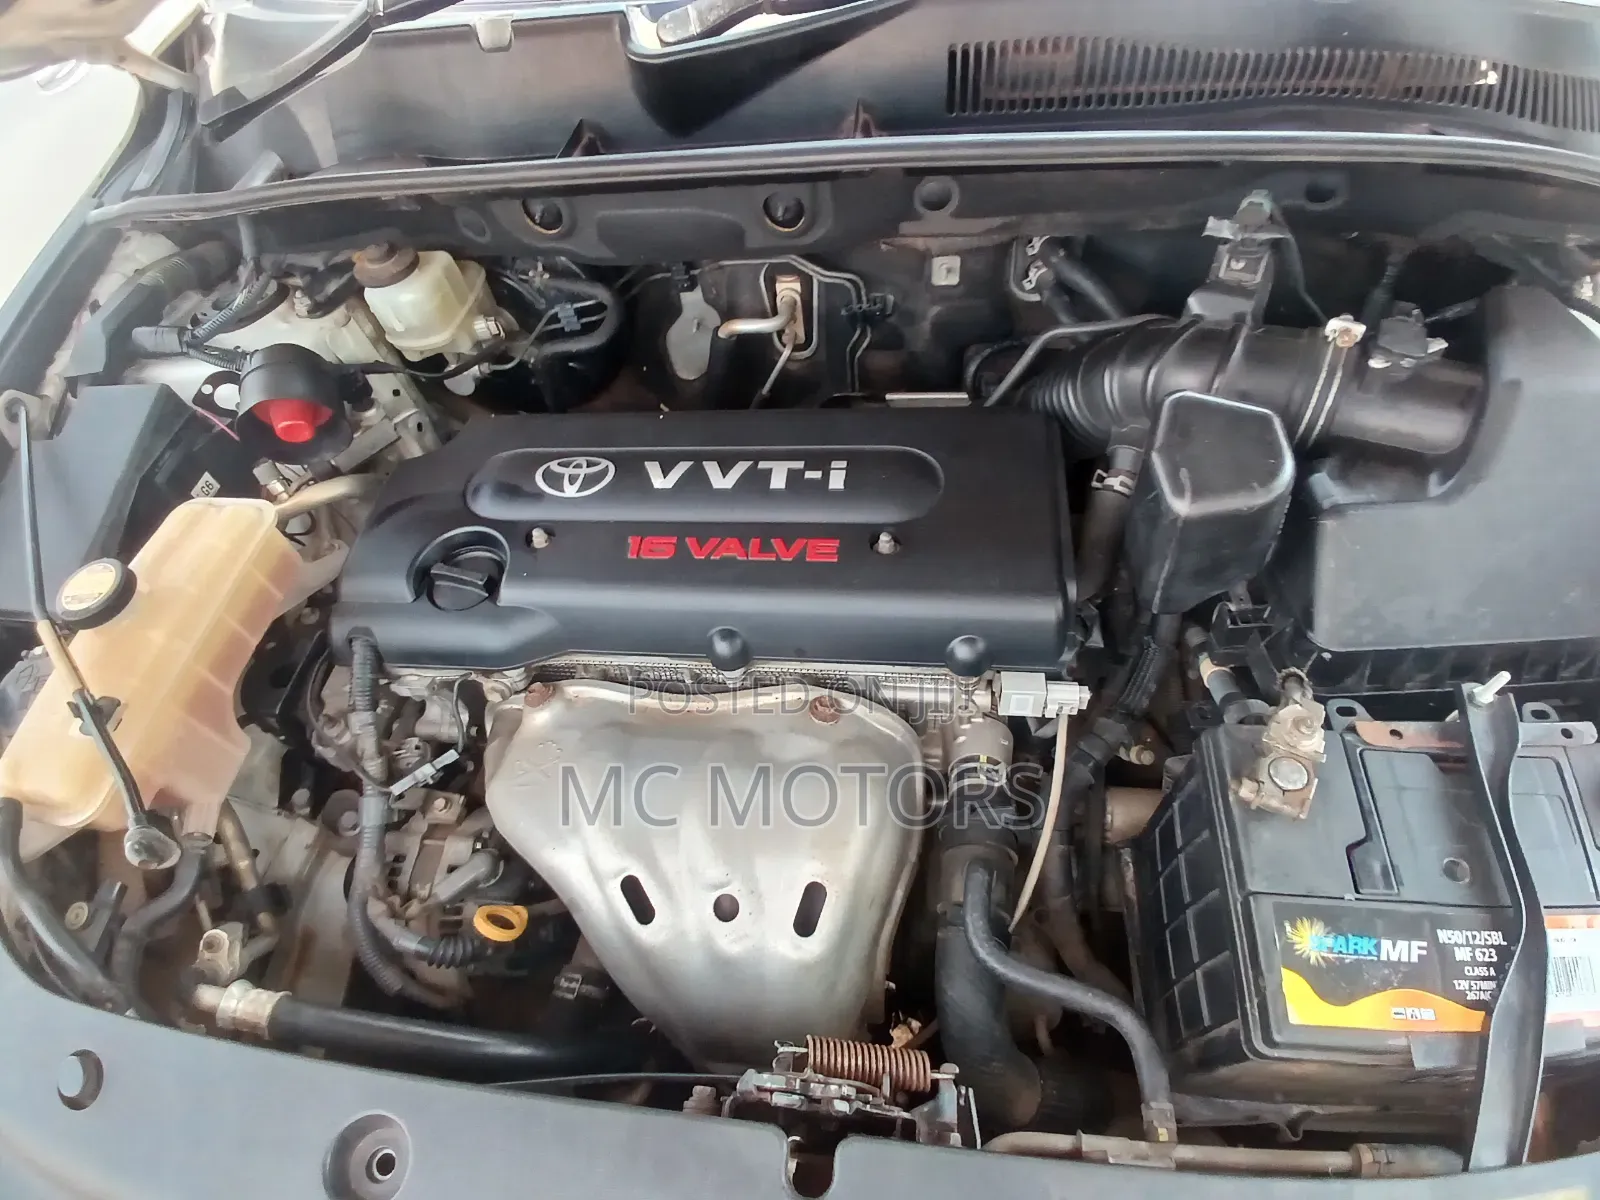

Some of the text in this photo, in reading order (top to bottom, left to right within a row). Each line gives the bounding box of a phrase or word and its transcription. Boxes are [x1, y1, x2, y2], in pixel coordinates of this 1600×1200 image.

[644, 460, 849, 490] VVT-i
[627, 535, 841, 563] 16 VALVE
[1380, 939, 1428, 963] MF
[1454, 946, 1498, 962] MF 623
[1464, 966, 1496, 976] CLASS A
